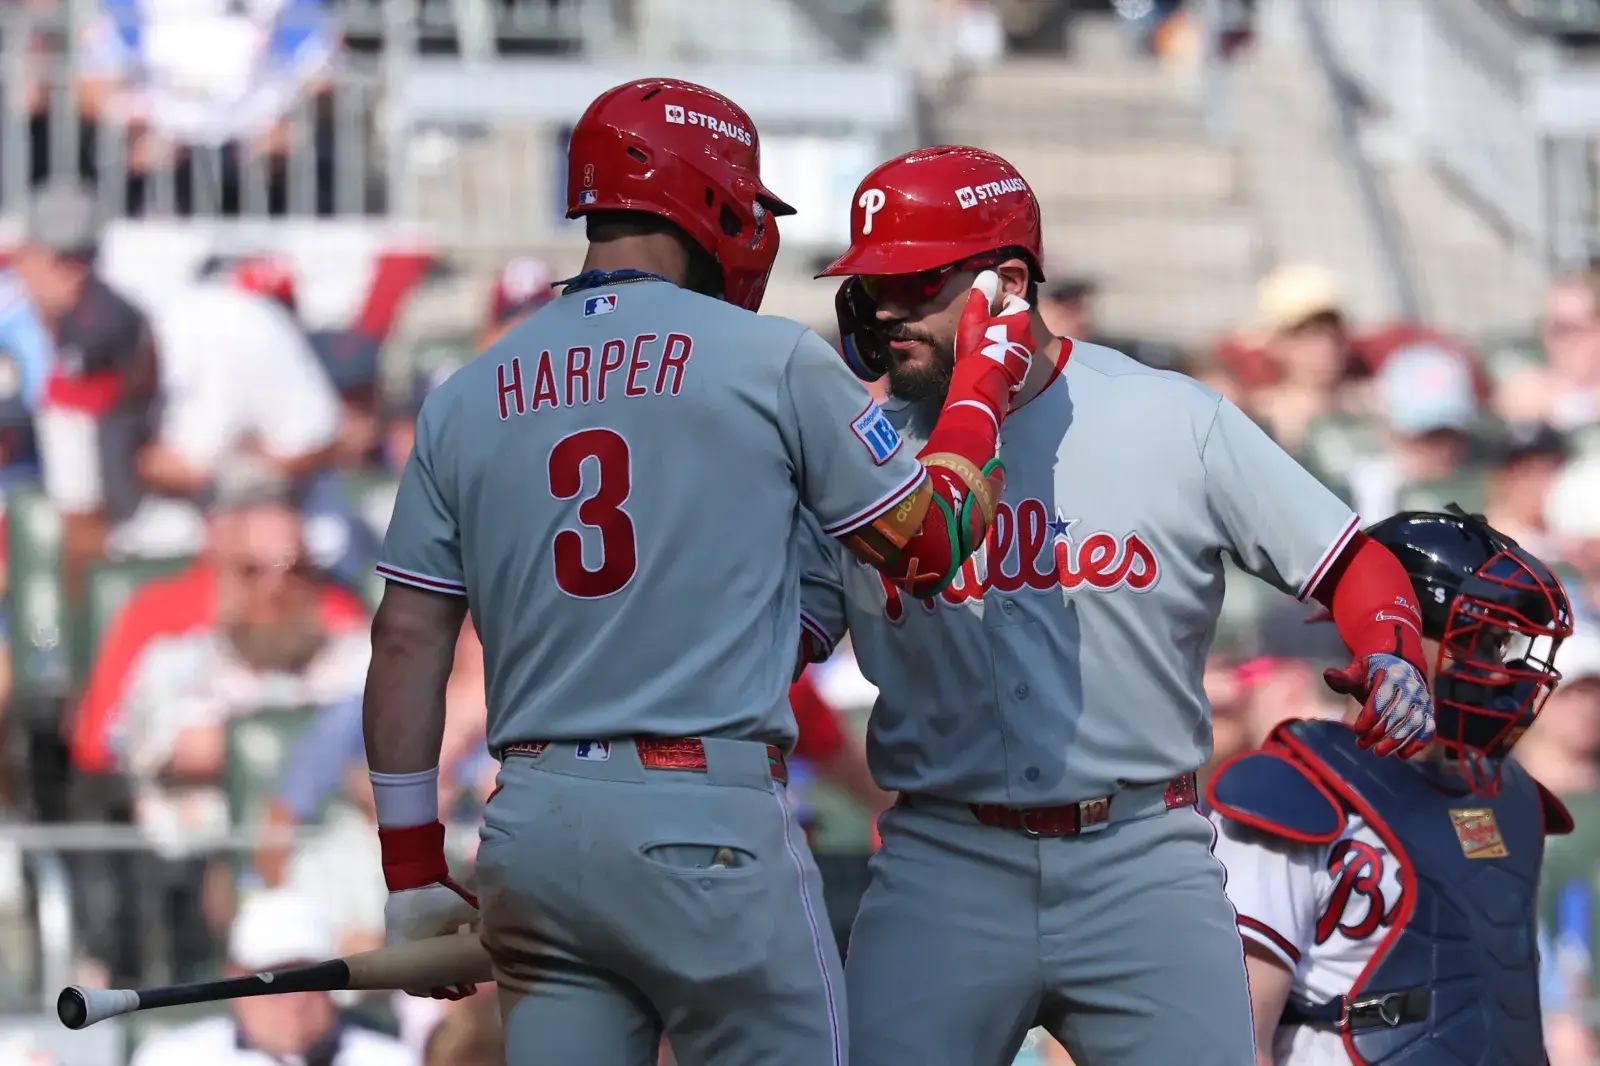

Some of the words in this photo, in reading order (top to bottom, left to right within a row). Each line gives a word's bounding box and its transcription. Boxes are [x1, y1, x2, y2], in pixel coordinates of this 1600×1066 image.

[688, 110, 752, 147] STRAUSS
[858, 188, 886, 236] P
[975, 177, 1027, 200] STRAUSS
[496, 331, 693, 420] HARPER
[864, 413, 899, 459] IB
[546, 426, 639, 600] 3
